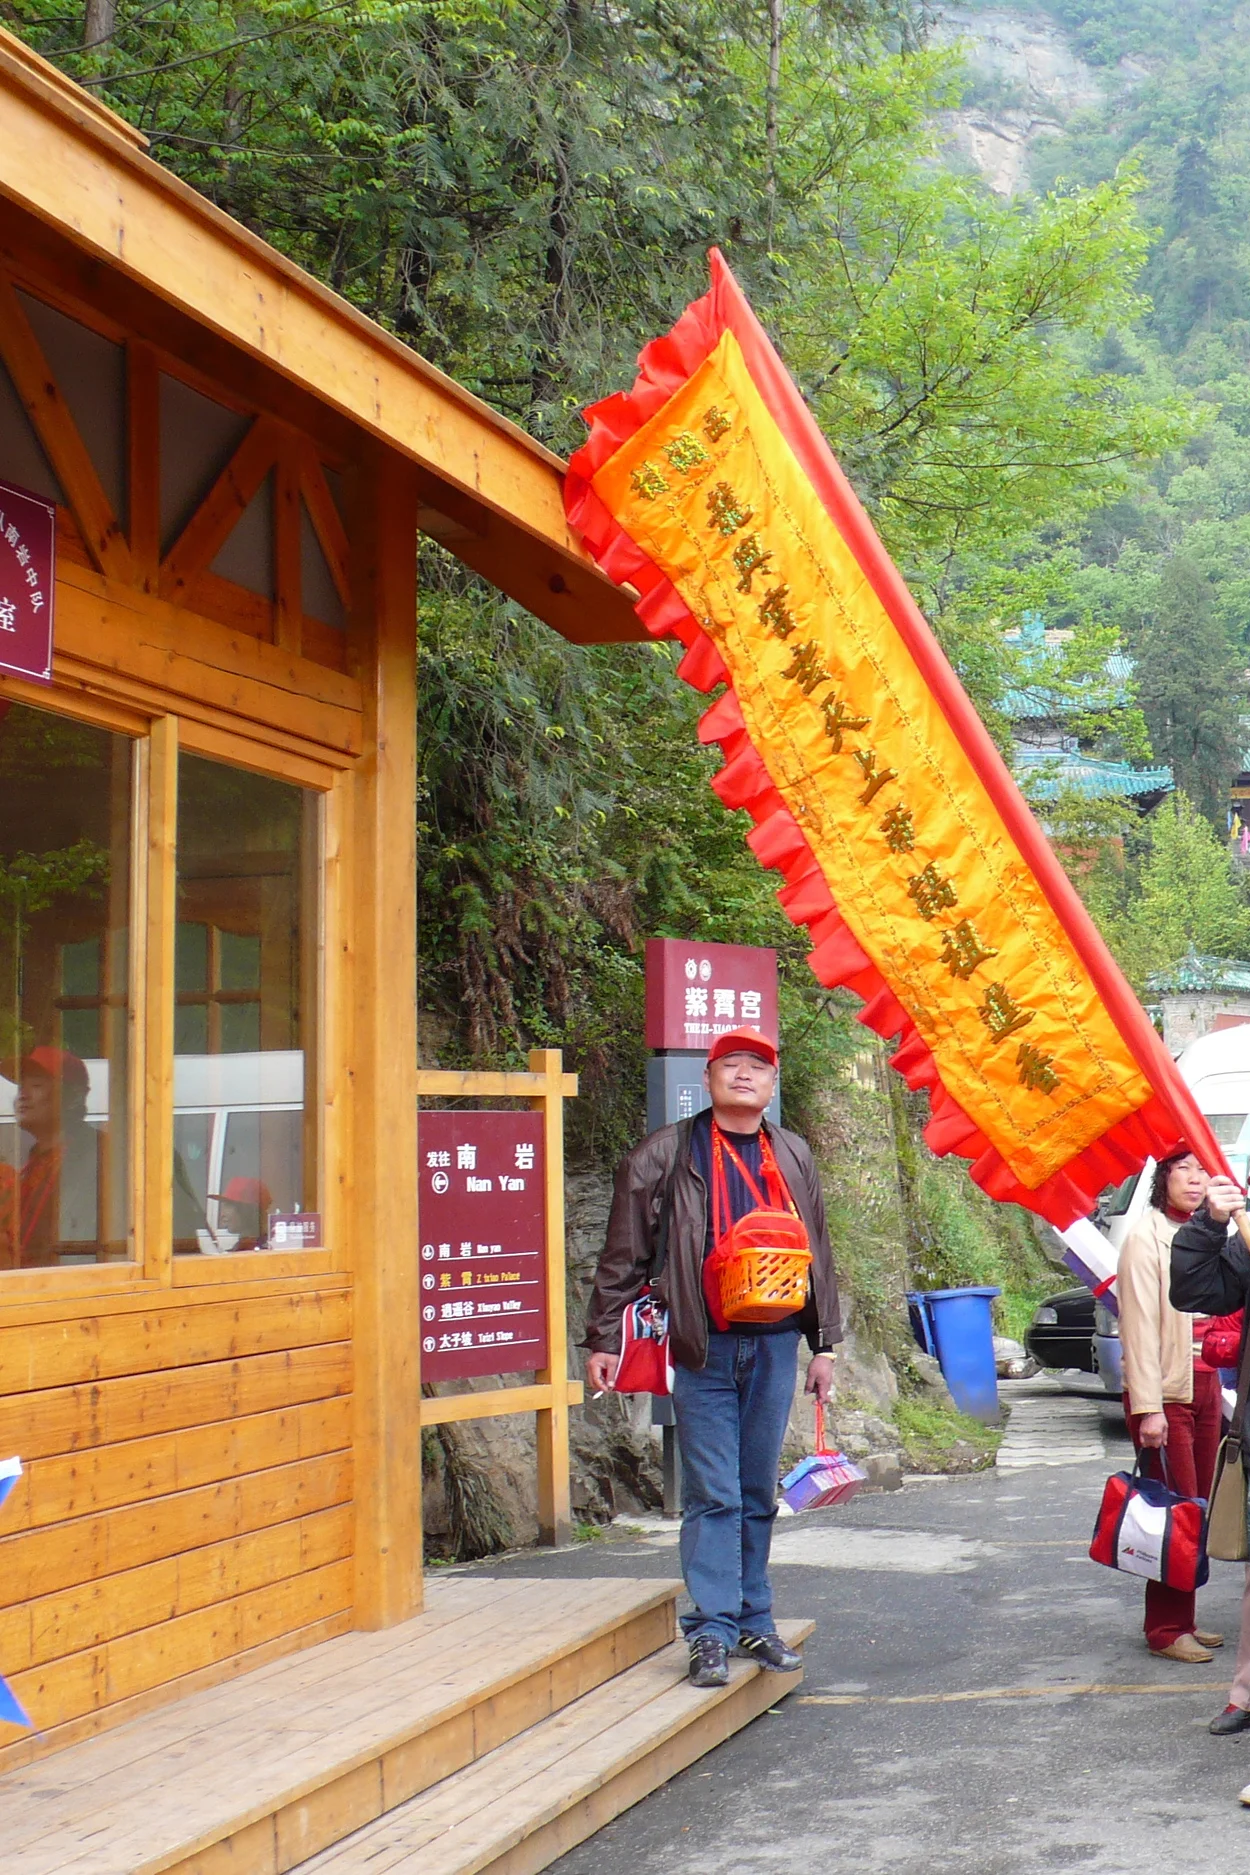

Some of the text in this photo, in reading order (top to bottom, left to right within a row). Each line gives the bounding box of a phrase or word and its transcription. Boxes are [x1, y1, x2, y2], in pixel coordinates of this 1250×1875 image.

[685, 987, 762, 1018] 紫霄宫
[426, 1151, 450, 1169] 发往
[467, 1175, 525, 1192] Nan Yan
[440, 1331, 473, 1348] 太子坡
